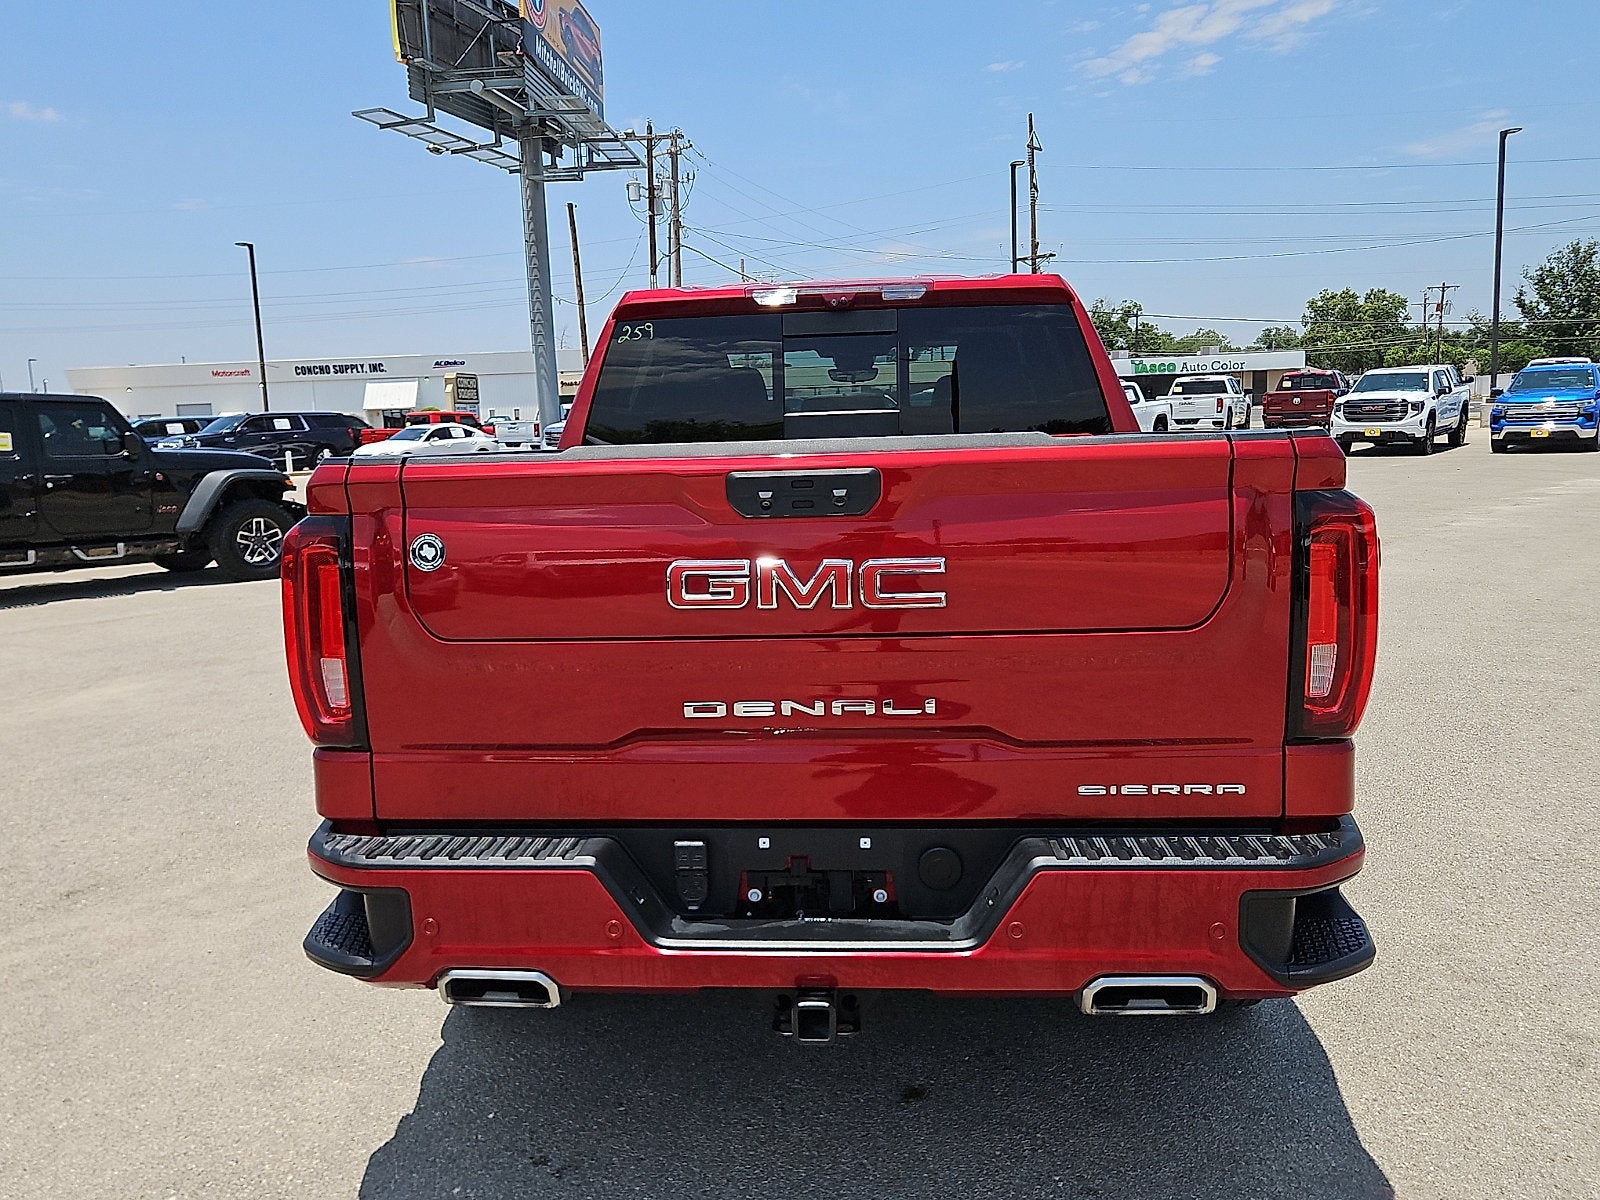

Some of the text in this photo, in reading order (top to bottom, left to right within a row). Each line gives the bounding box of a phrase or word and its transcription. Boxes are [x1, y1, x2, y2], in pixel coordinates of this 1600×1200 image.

[617, 322, 654, 344] 259
[294, 364, 331, 376] CONCHO
[368, 362, 387, 374] INC.
[1180, 361, 1208, 372] Auto
[1211, 360, 1246, 371] Color
[666, 556, 947, 610] GMC
[683, 698, 937, 719] DENALI
[1077, 784, 1246, 796] SIERRA
